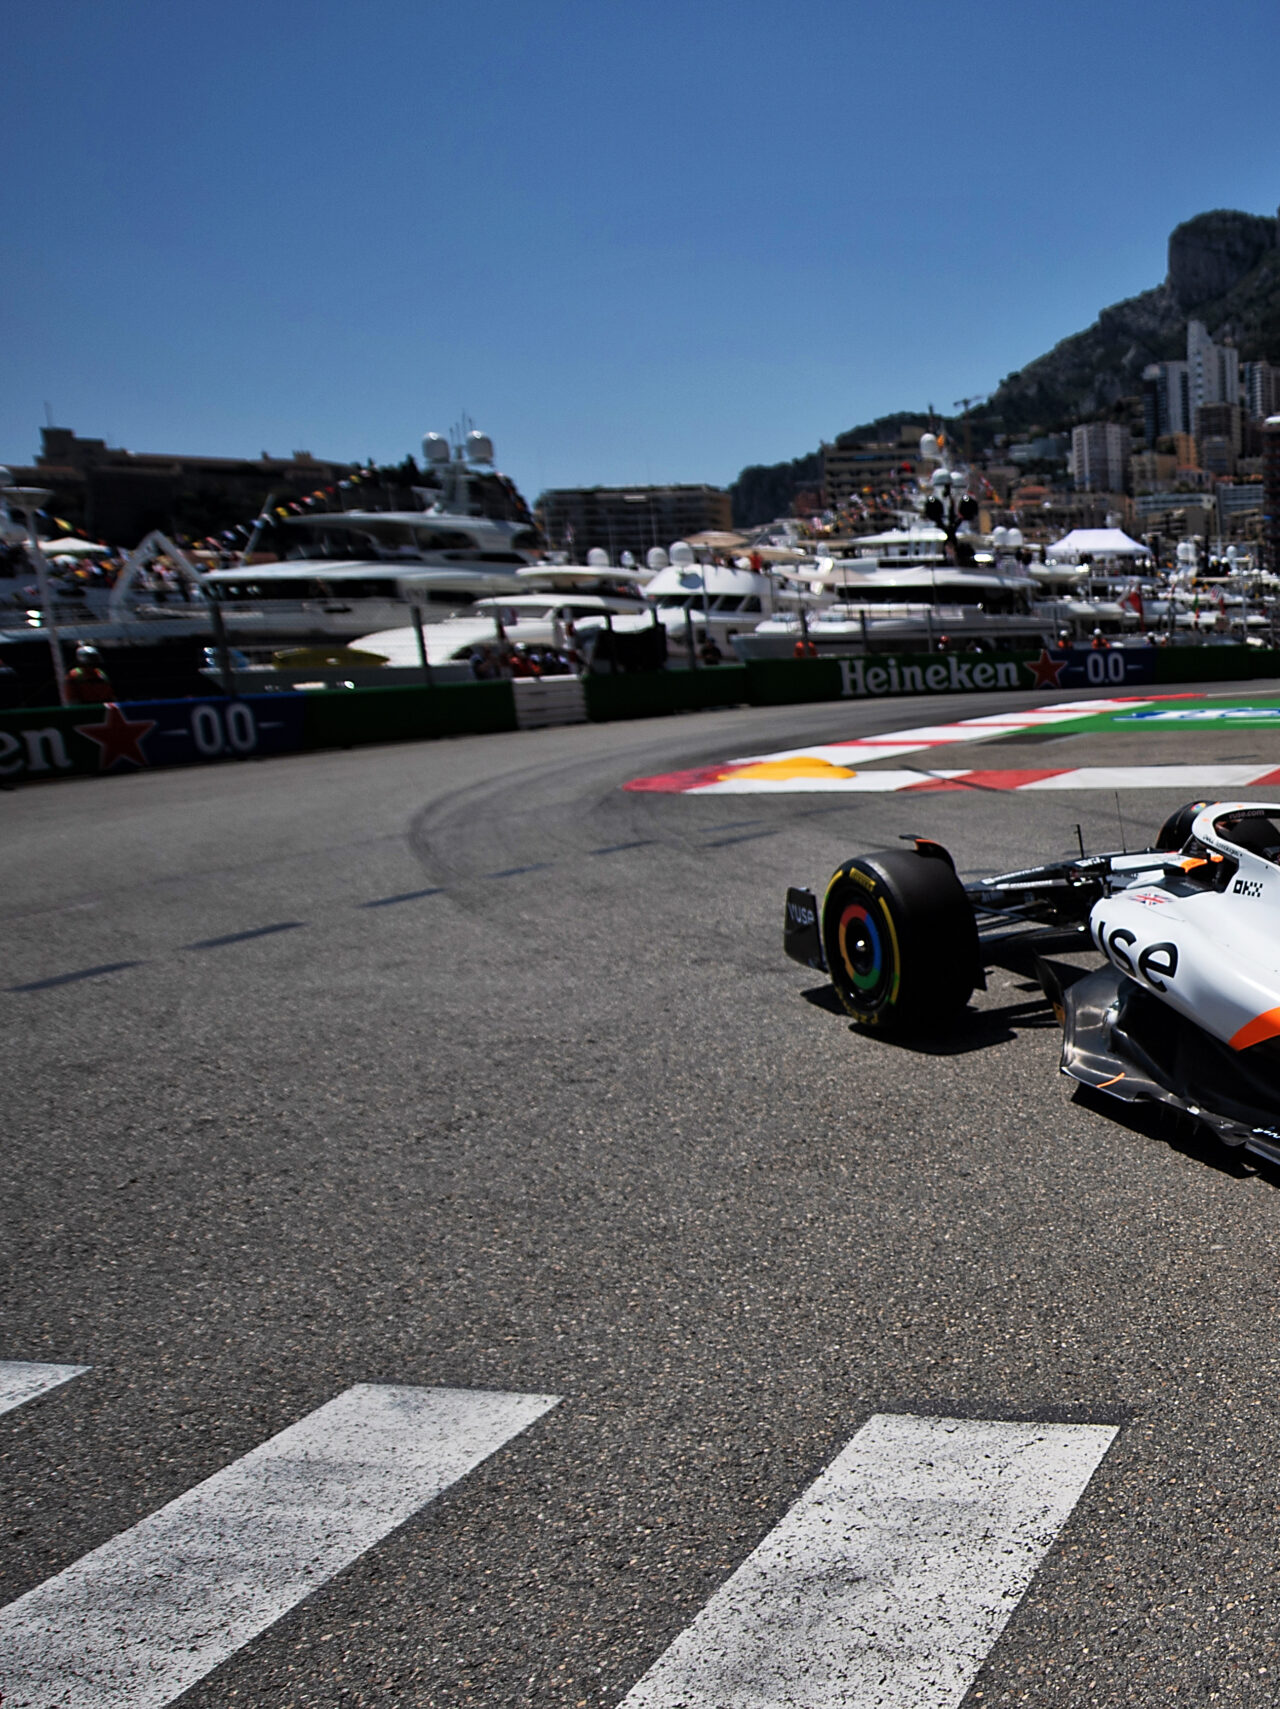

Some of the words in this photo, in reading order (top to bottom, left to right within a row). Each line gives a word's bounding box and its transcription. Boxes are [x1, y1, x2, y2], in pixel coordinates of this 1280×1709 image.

[838, 657, 1020, 696] Heineken
[1086, 652, 1125, 684] 0.0
[1233, 879, 1263, 897] OKX
